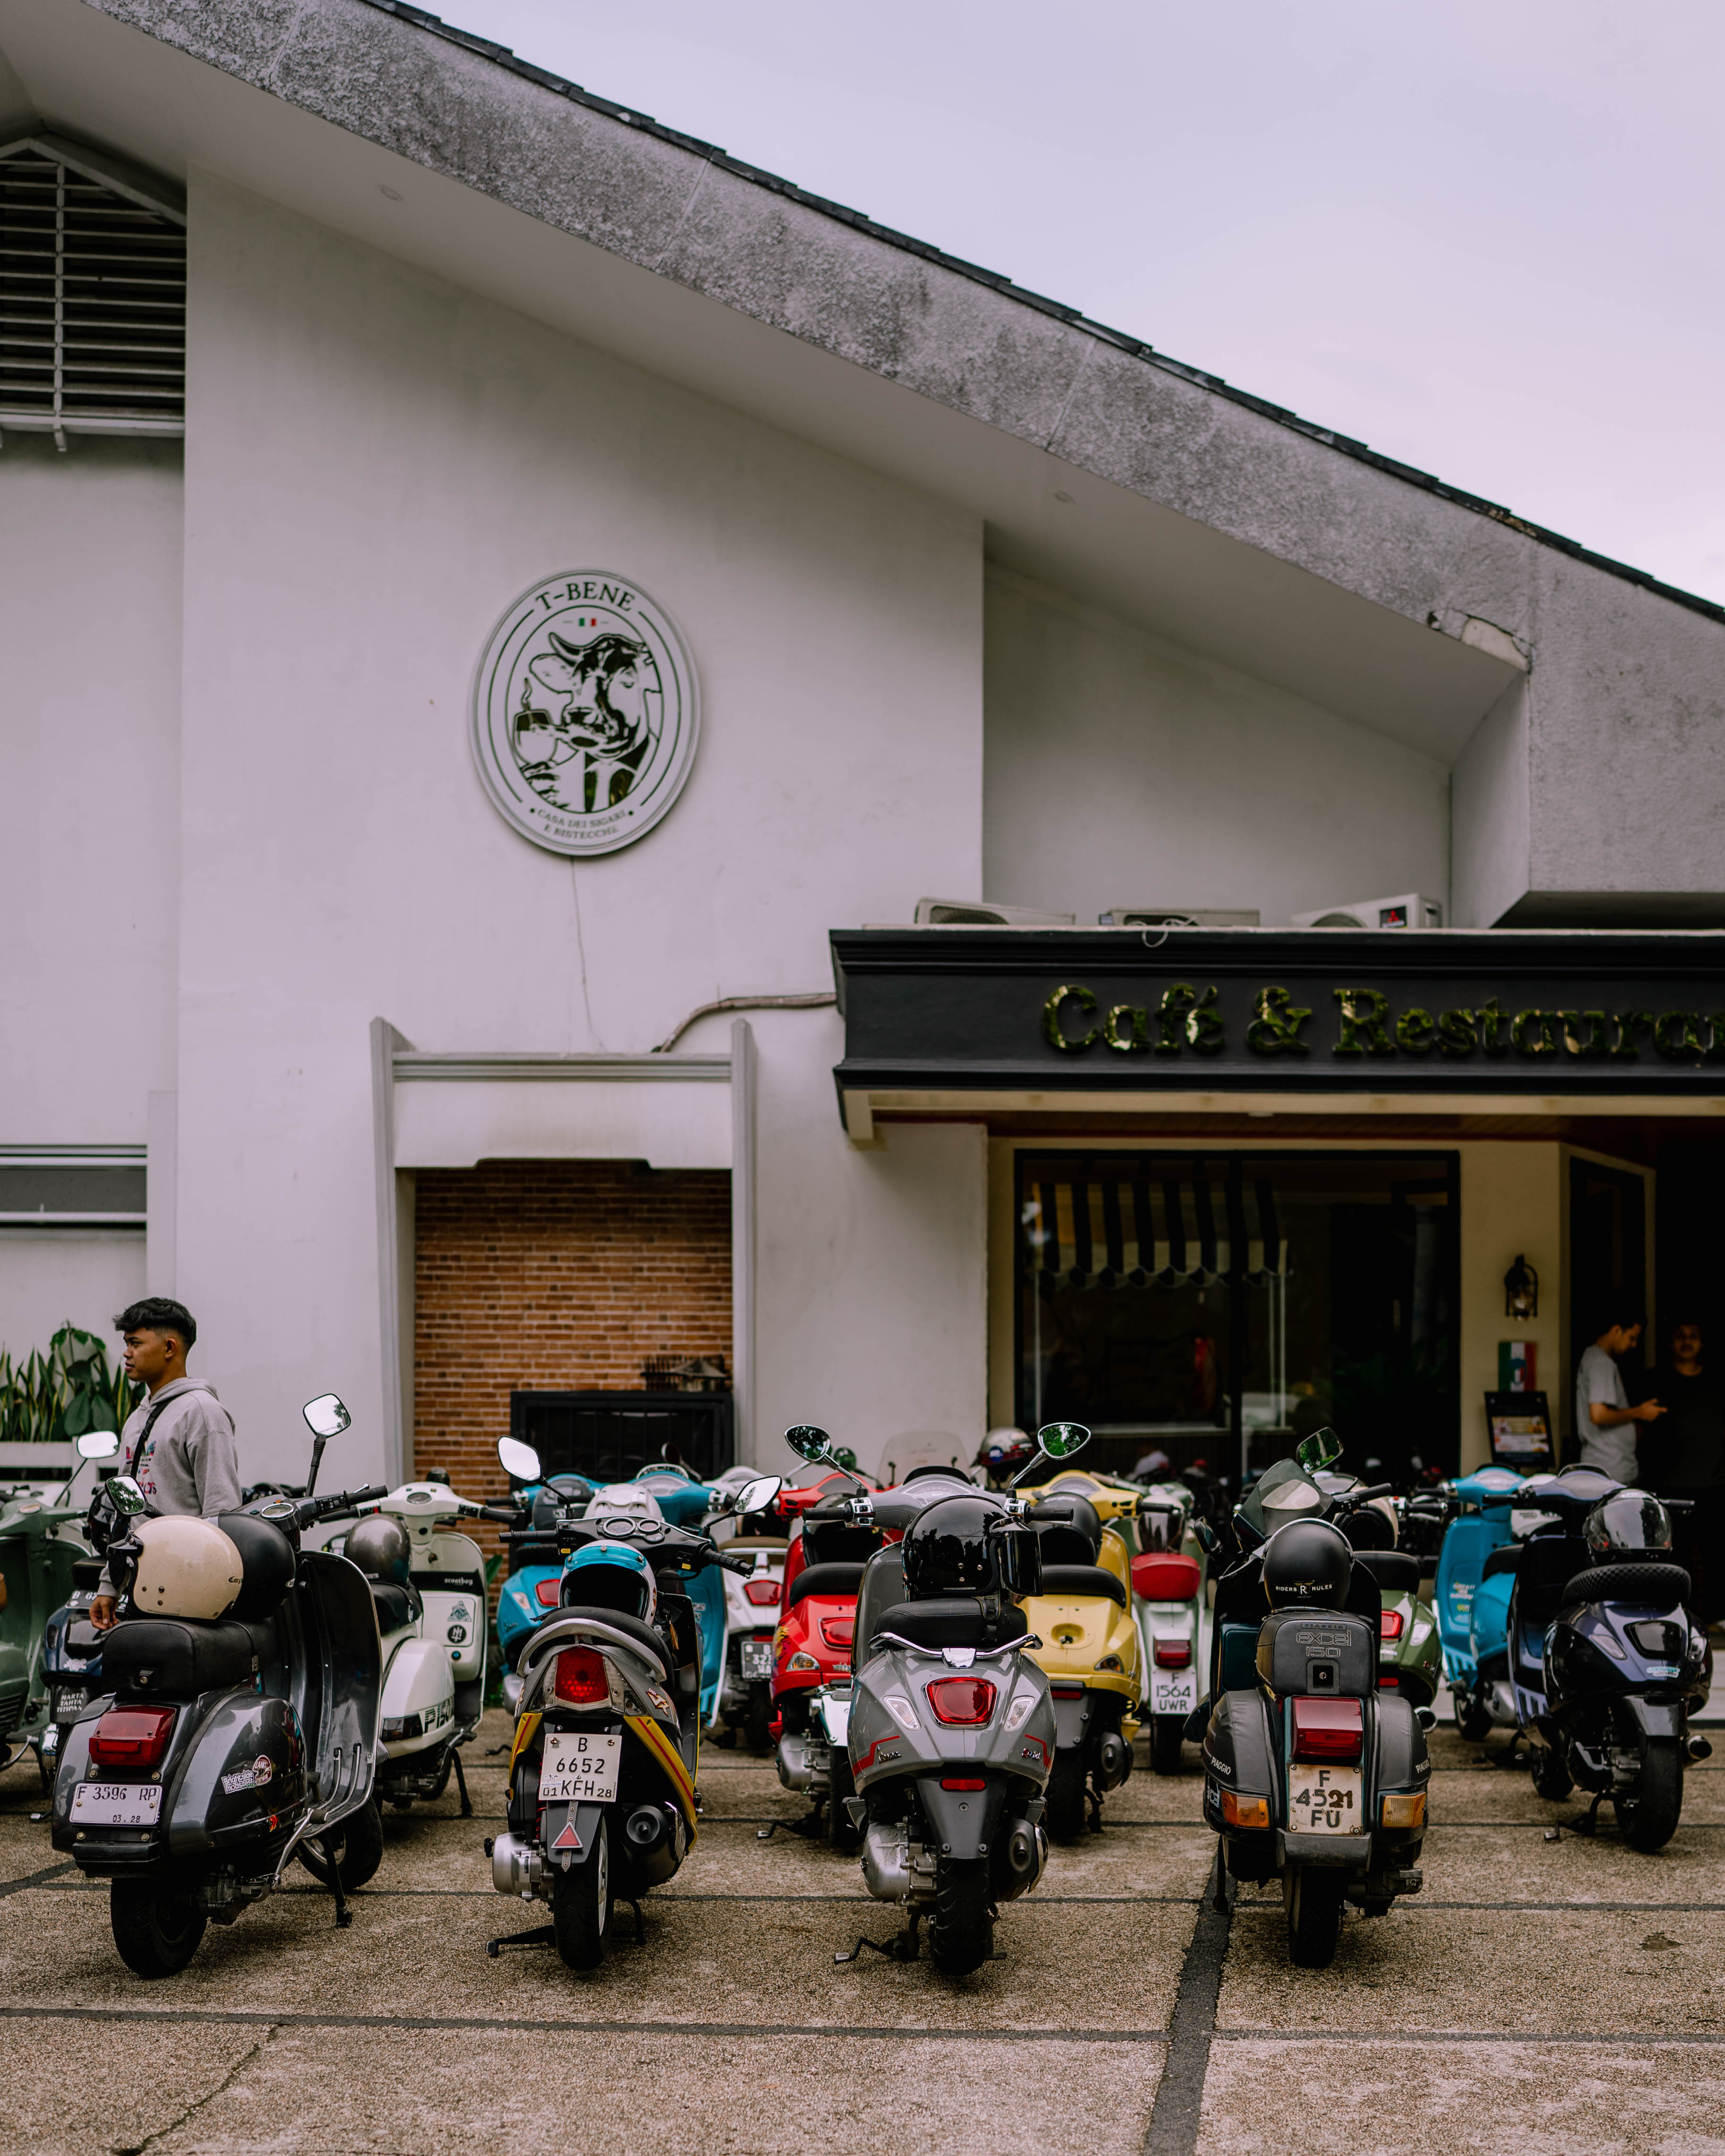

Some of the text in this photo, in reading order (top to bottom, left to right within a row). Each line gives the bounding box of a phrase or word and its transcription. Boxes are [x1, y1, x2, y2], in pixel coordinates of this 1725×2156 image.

[535, 582, 636, 611] T-BENE
[568, 819, 586, 828] DEI
[1043, 983, 1226, 1052] Café
[1247, 985, 1312, 1054] &
[1300, 1585, 1307, 1595] R
[1296, 1630, 1352, 1647] excel
[1306, 1646, 1341, 1658] 150
[1172, 1673, 1180, 1683] F
[1156, 1685, 1191, 1698] 1564
[1159, 1699, 1188, 1711] UWR
[578, 1737, 588, 1752] B
[556, 1758, 605, 1774] 6652
[1211, 1756, 1231, 1775] PIAGGIO
[223, 1771, 253, 1785] Brightside
[1319, 1770, 1330, 1787] F
[78, 1786, 156, 1801] F 3596 RP
[543, 1788, 557, 1796] 01
[561, 1780, 595, 1796] KFH
[596, 1788, 612, 1797] 28
[1296, 1789, 1353, 1809] 4521
[1311, 1810, 1340, 1828] FU
